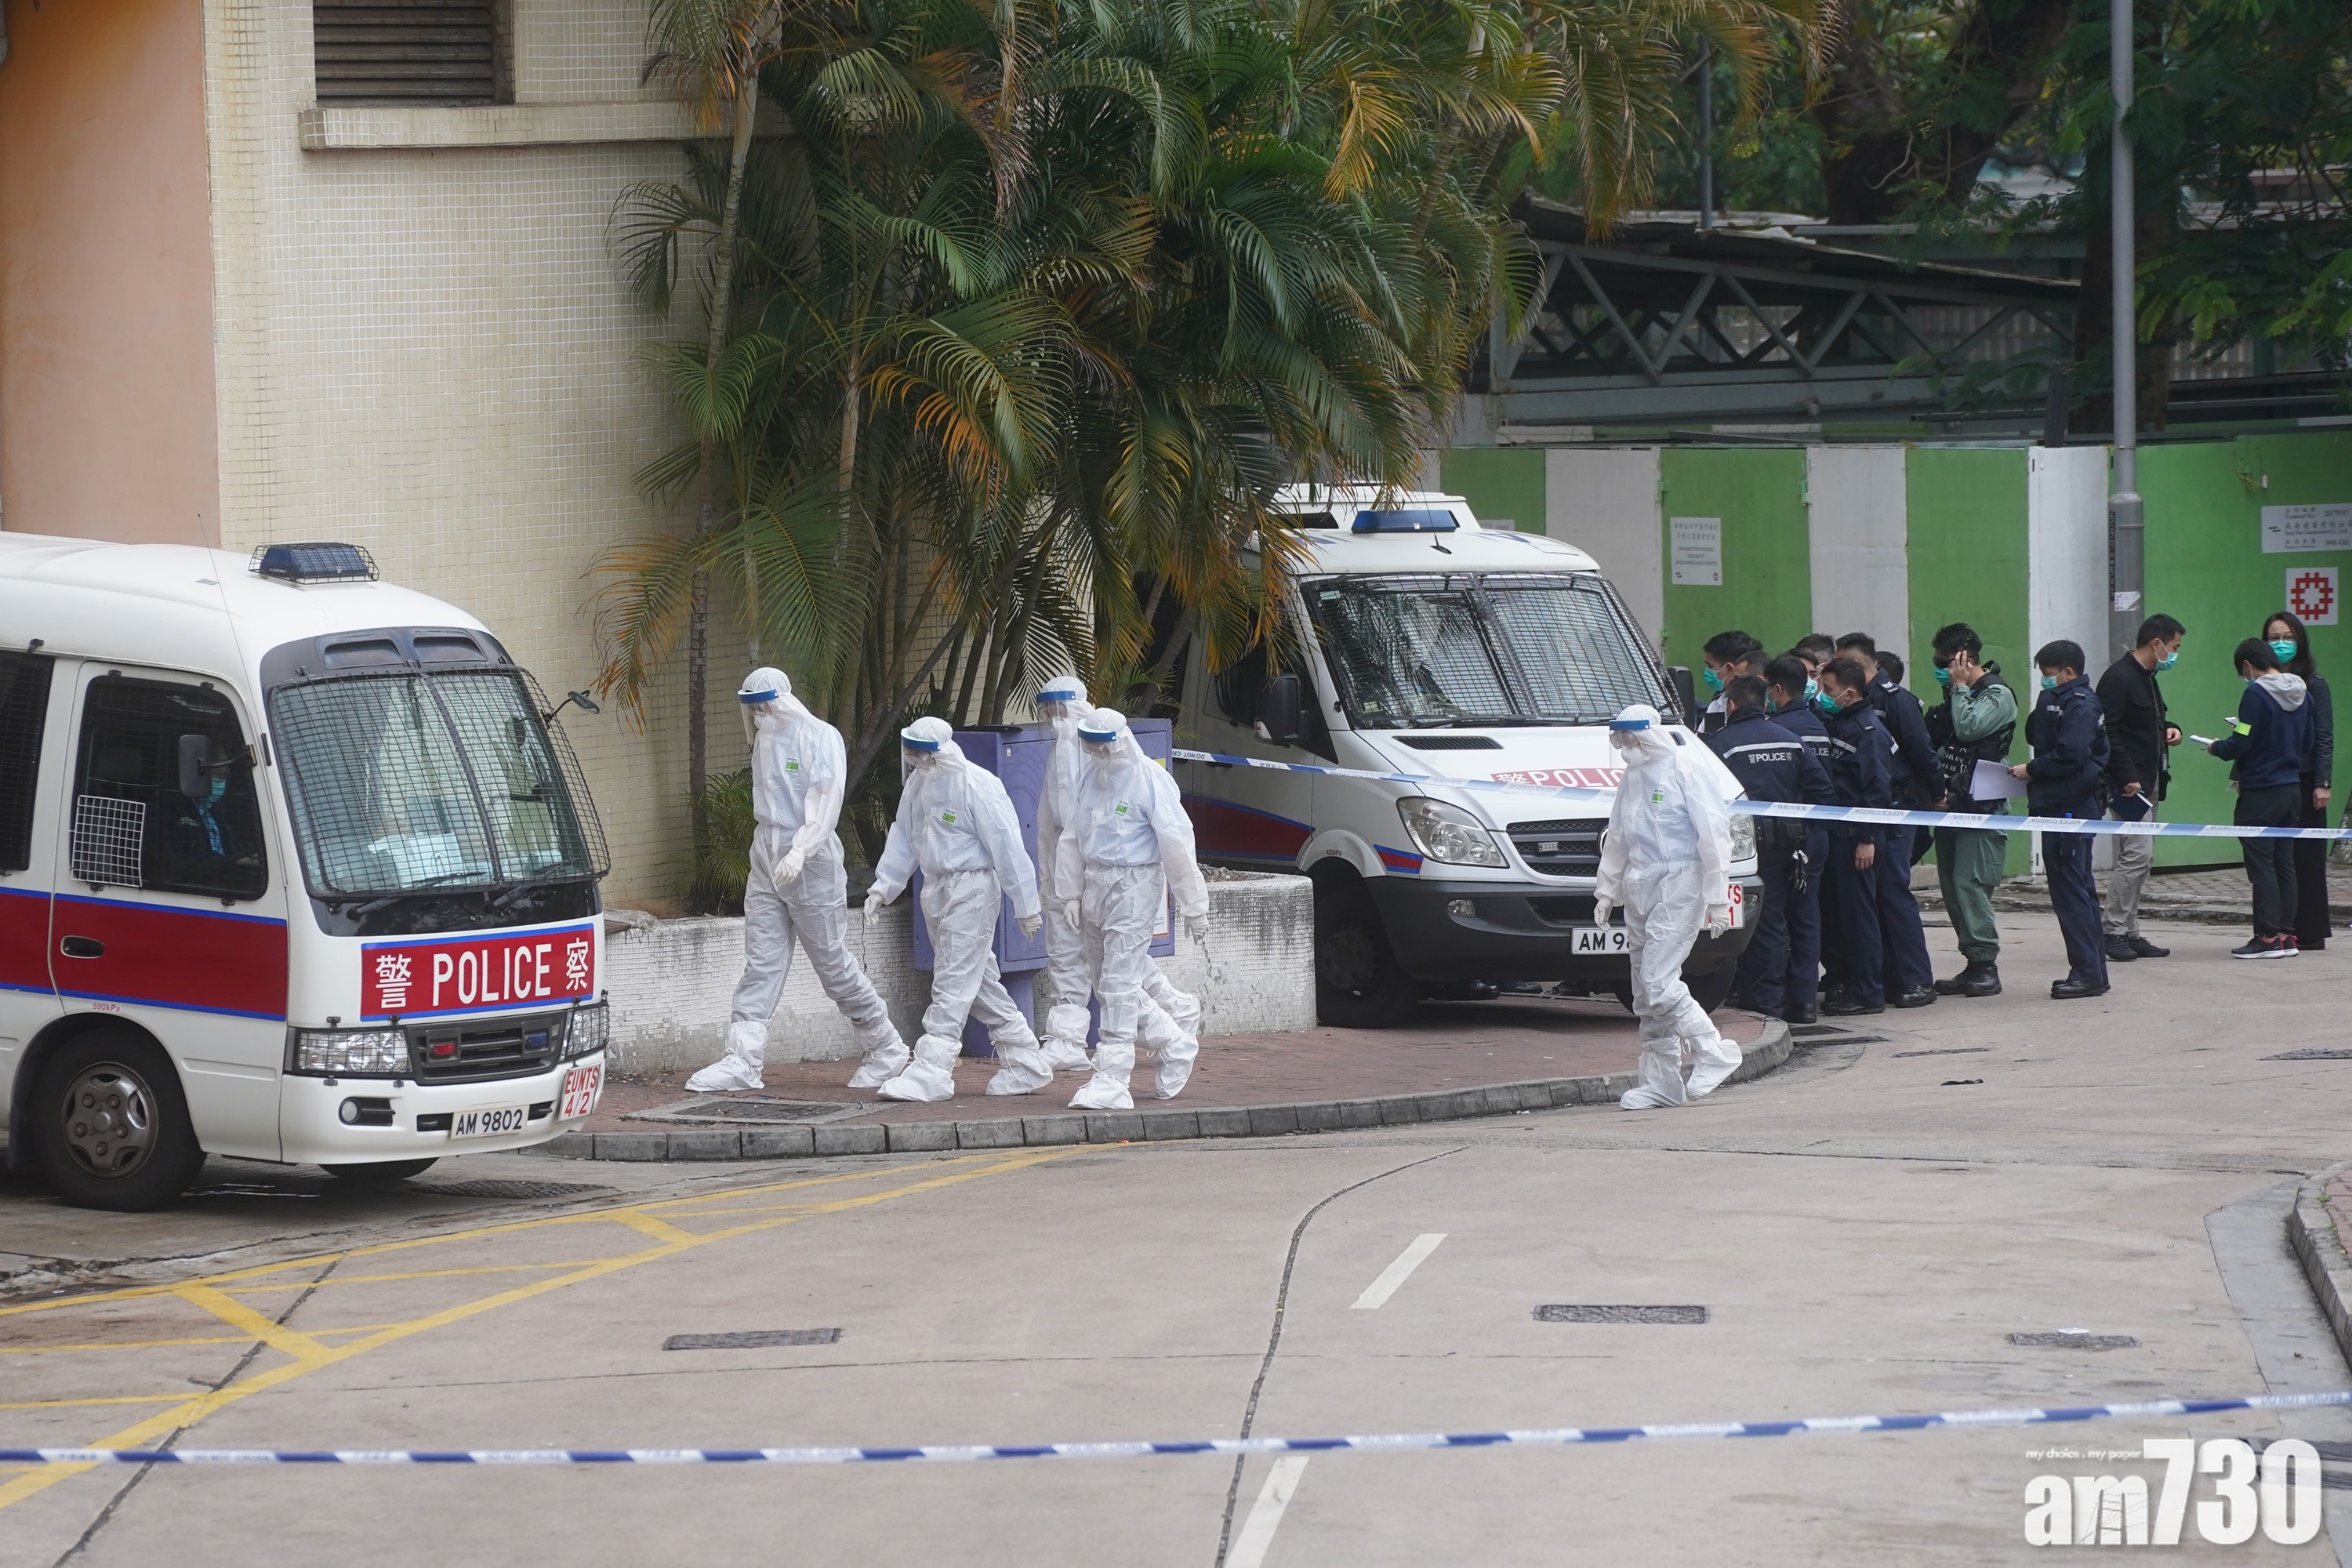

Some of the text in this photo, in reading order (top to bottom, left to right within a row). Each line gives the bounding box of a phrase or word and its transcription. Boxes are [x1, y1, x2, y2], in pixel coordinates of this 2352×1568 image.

[1579, 932, 1606, 951] AM
[432, 943, 552, 1007] POLICE
[93, 1003, 120, 1011] 590kPa
[564, 1066, 599, 1094] EUNTS
[564, 1091, 590, 1118] 4/2
[456, 1109, 523, 1135] AM 9802
